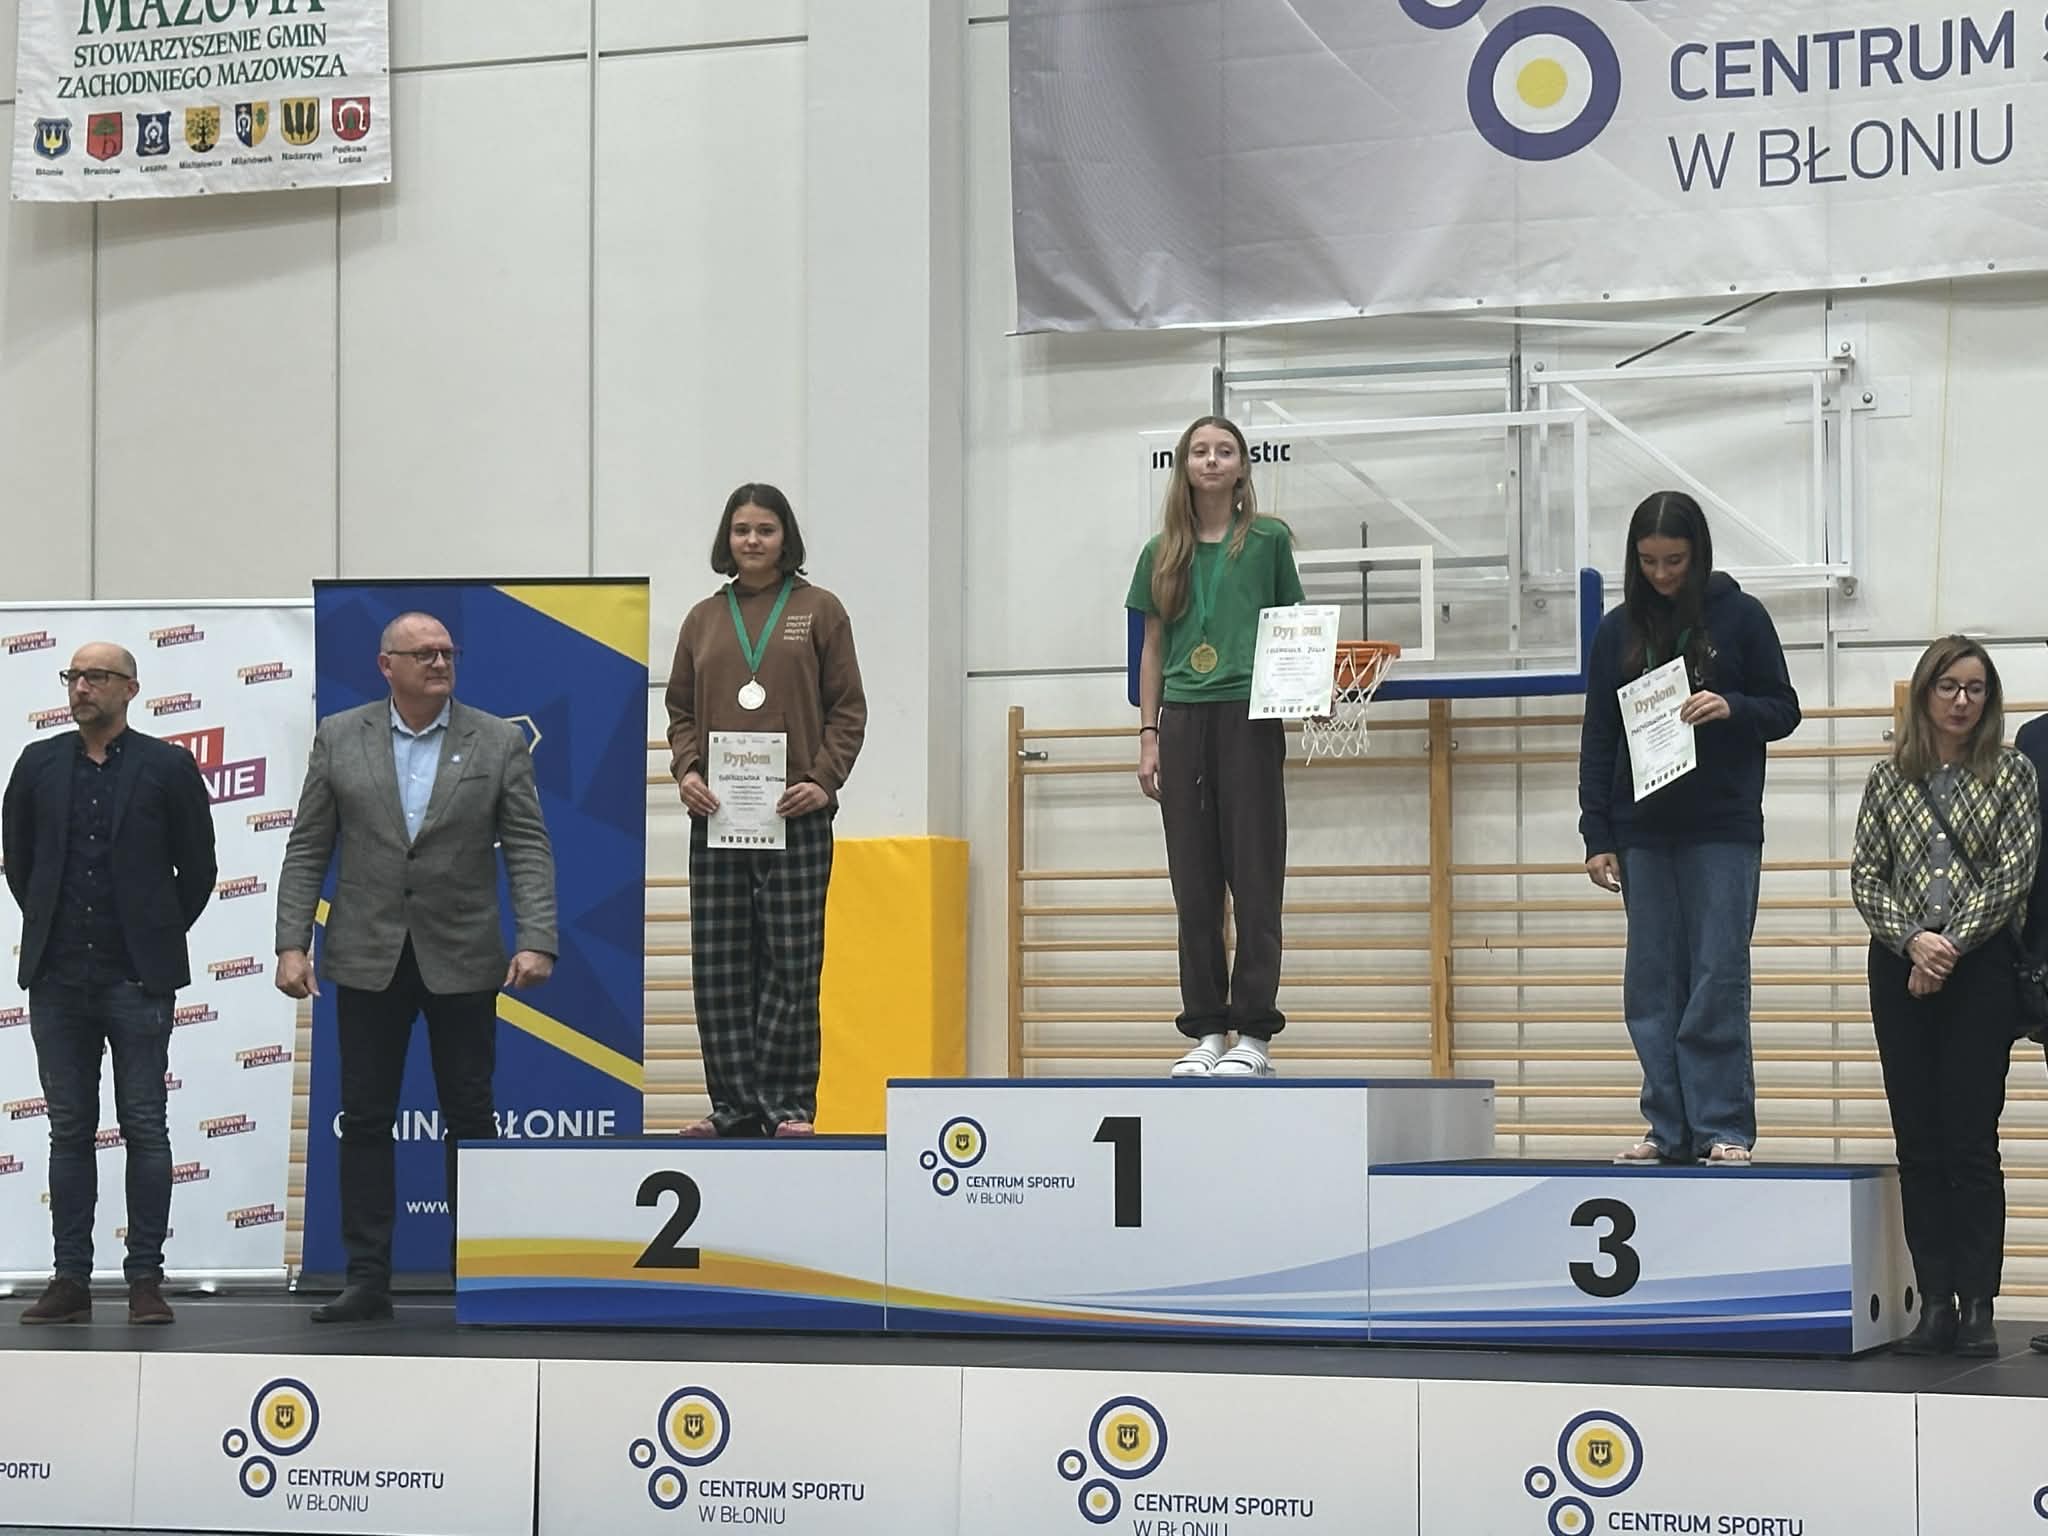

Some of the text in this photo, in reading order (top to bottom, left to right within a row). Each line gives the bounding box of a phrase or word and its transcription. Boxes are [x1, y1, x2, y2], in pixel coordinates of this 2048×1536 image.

[73, 23, 328, 68] STOWARZYSZENIE GMIN
[1670, 10, 2014, 100] CENTRUM
[57, 53, 348, 99] ZACHODNIEGO MAZOWSZA
[1668, 103, 2013, 192] W BŁONIU
[1633, 685, 1676, 714] Dyplom
[723, 751, 771, 767] Dyplom
[966, 1176, 1075, 1188] CENTRUM SPORTU
[1093, 1117, 1142, 1227] 1
[966, 1193, 1024, 1204] W BŁONIU
[633, 1171, 700, 1269] 2
[1569, 1198, 1640, 1297] 3
[0, 1462, 50, 1479] PORTU
[287, 1469, 444, 1489] CENTRUM SPORTU
[699, 1480, 864, 1501] CENTRUM SPORTU
[286, 1494, 369, 1512] W BŁONIU
[698, 1505, 786, 1524] W BŁONIU
[1133, 1493, 1313, 1517] CENTRUM SPORTU
[1133, 1520, 1152, 1536] W
[1608, 1512, 1803, 1536] CENTRUM SPORTU
